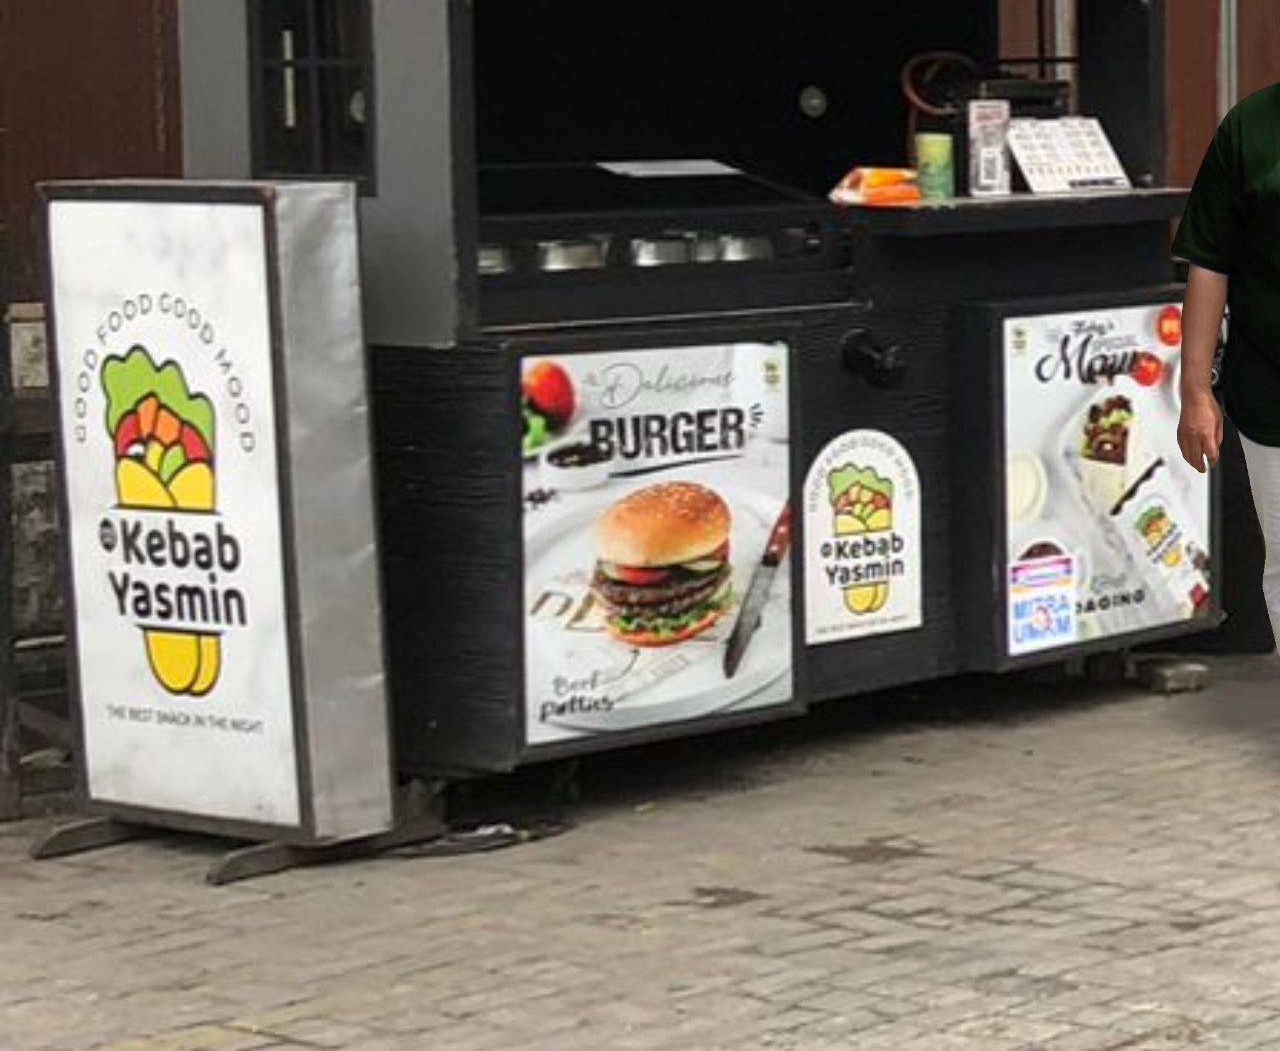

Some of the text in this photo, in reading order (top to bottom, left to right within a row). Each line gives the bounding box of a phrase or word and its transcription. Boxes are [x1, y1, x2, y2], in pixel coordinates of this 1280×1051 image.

[600, 362, 735, 410] Delicious
[589, 407, 745, 462] BURGER
[120, 518, 240, 573] Kebab
[825, 555, 904, 585] Yasmin
[834, 532, 904, 561] Kebab
[108, 570, 247, 626] Yasmin
